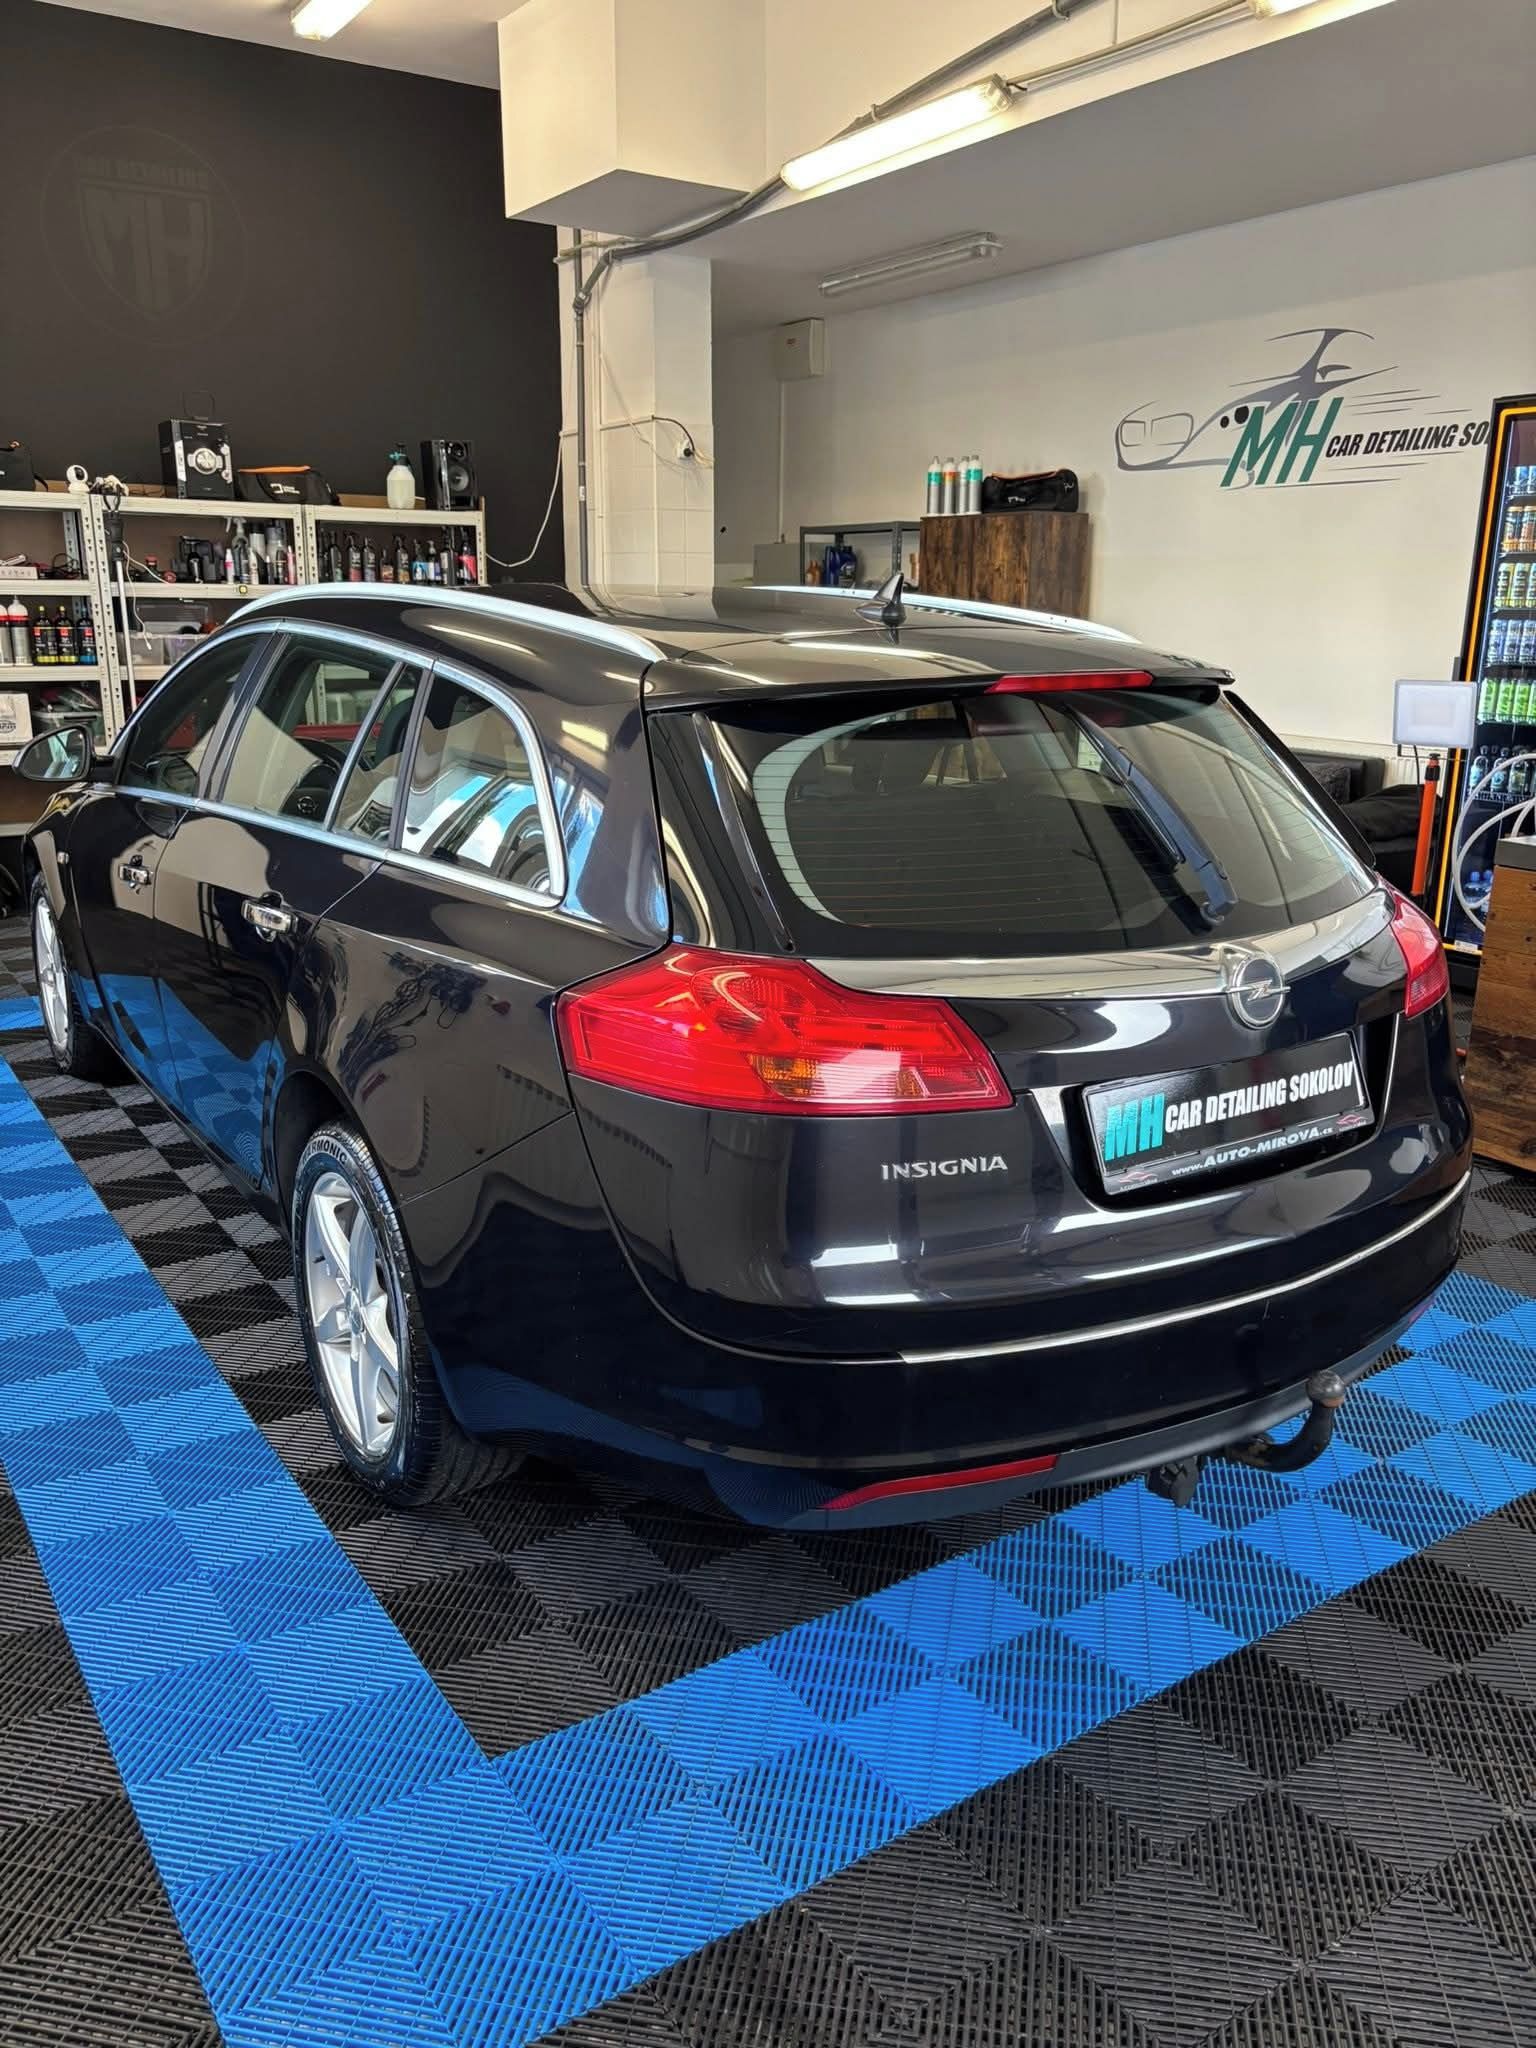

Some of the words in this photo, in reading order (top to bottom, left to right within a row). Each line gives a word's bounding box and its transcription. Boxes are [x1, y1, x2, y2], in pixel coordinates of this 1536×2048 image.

[85, 188, 204, 309] MH
[1220, 397, 1344, 487] MH
[1325, 434, 1364, 458] CAR
[1363, 424, 1459, 455] DETAILING
[1459, 421, 1490, 447] SO
[1103, 1092, 1165, 1161] MH
[1165, 1099, 1202, 1133] CAR
[1205, 1078, 1287, 1124] DETAILING
[1289, 1060, 1354, 1102] SOKOLOV
[881, 1156, 1008, 1180] INSIGNIA
